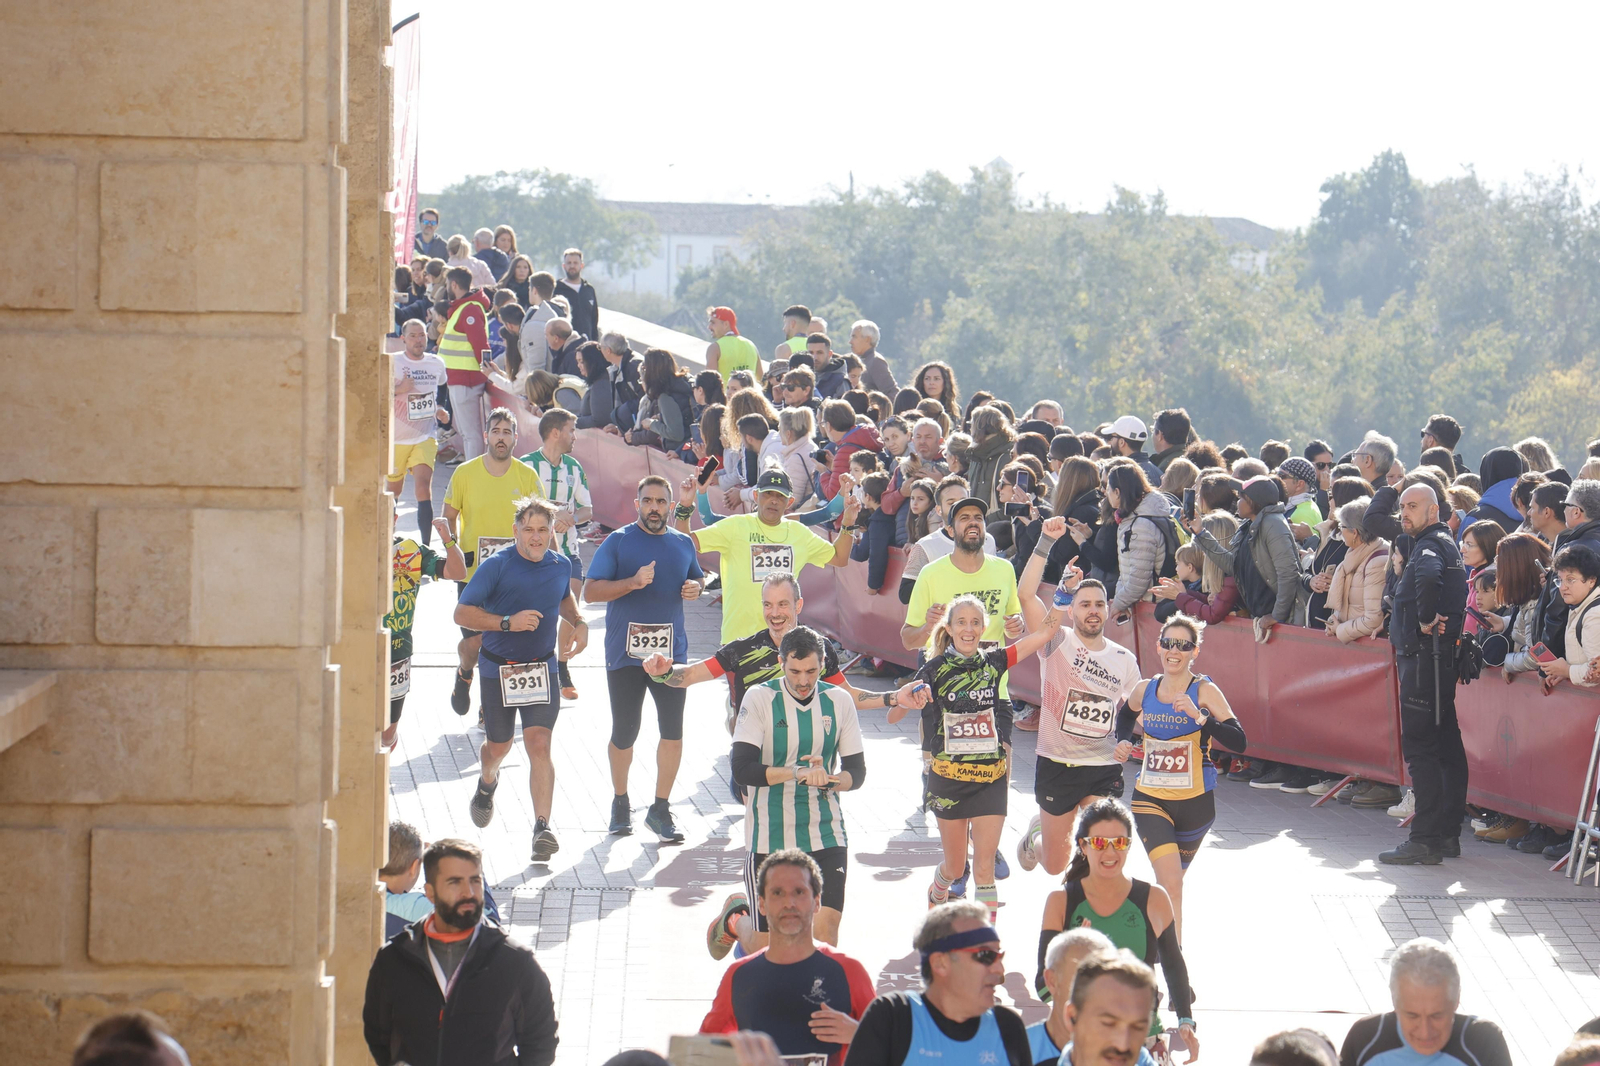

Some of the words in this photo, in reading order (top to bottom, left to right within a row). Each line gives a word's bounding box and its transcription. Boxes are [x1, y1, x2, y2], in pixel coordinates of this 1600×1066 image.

[410, 399, 433, 411] 3899
[755, 555, 790, 568] 2365
[631, 635, 669, 648] 3932
[1073, 658, 1085, 668] 37
[508, 675, 543, 690] 3931
[1067, 703, 1111, 724] 4829
[952, 722, 990, 737] 3518
[1148, 753, 1186, 770] 3799
[957, 767, 994, 779] KAMUABU
